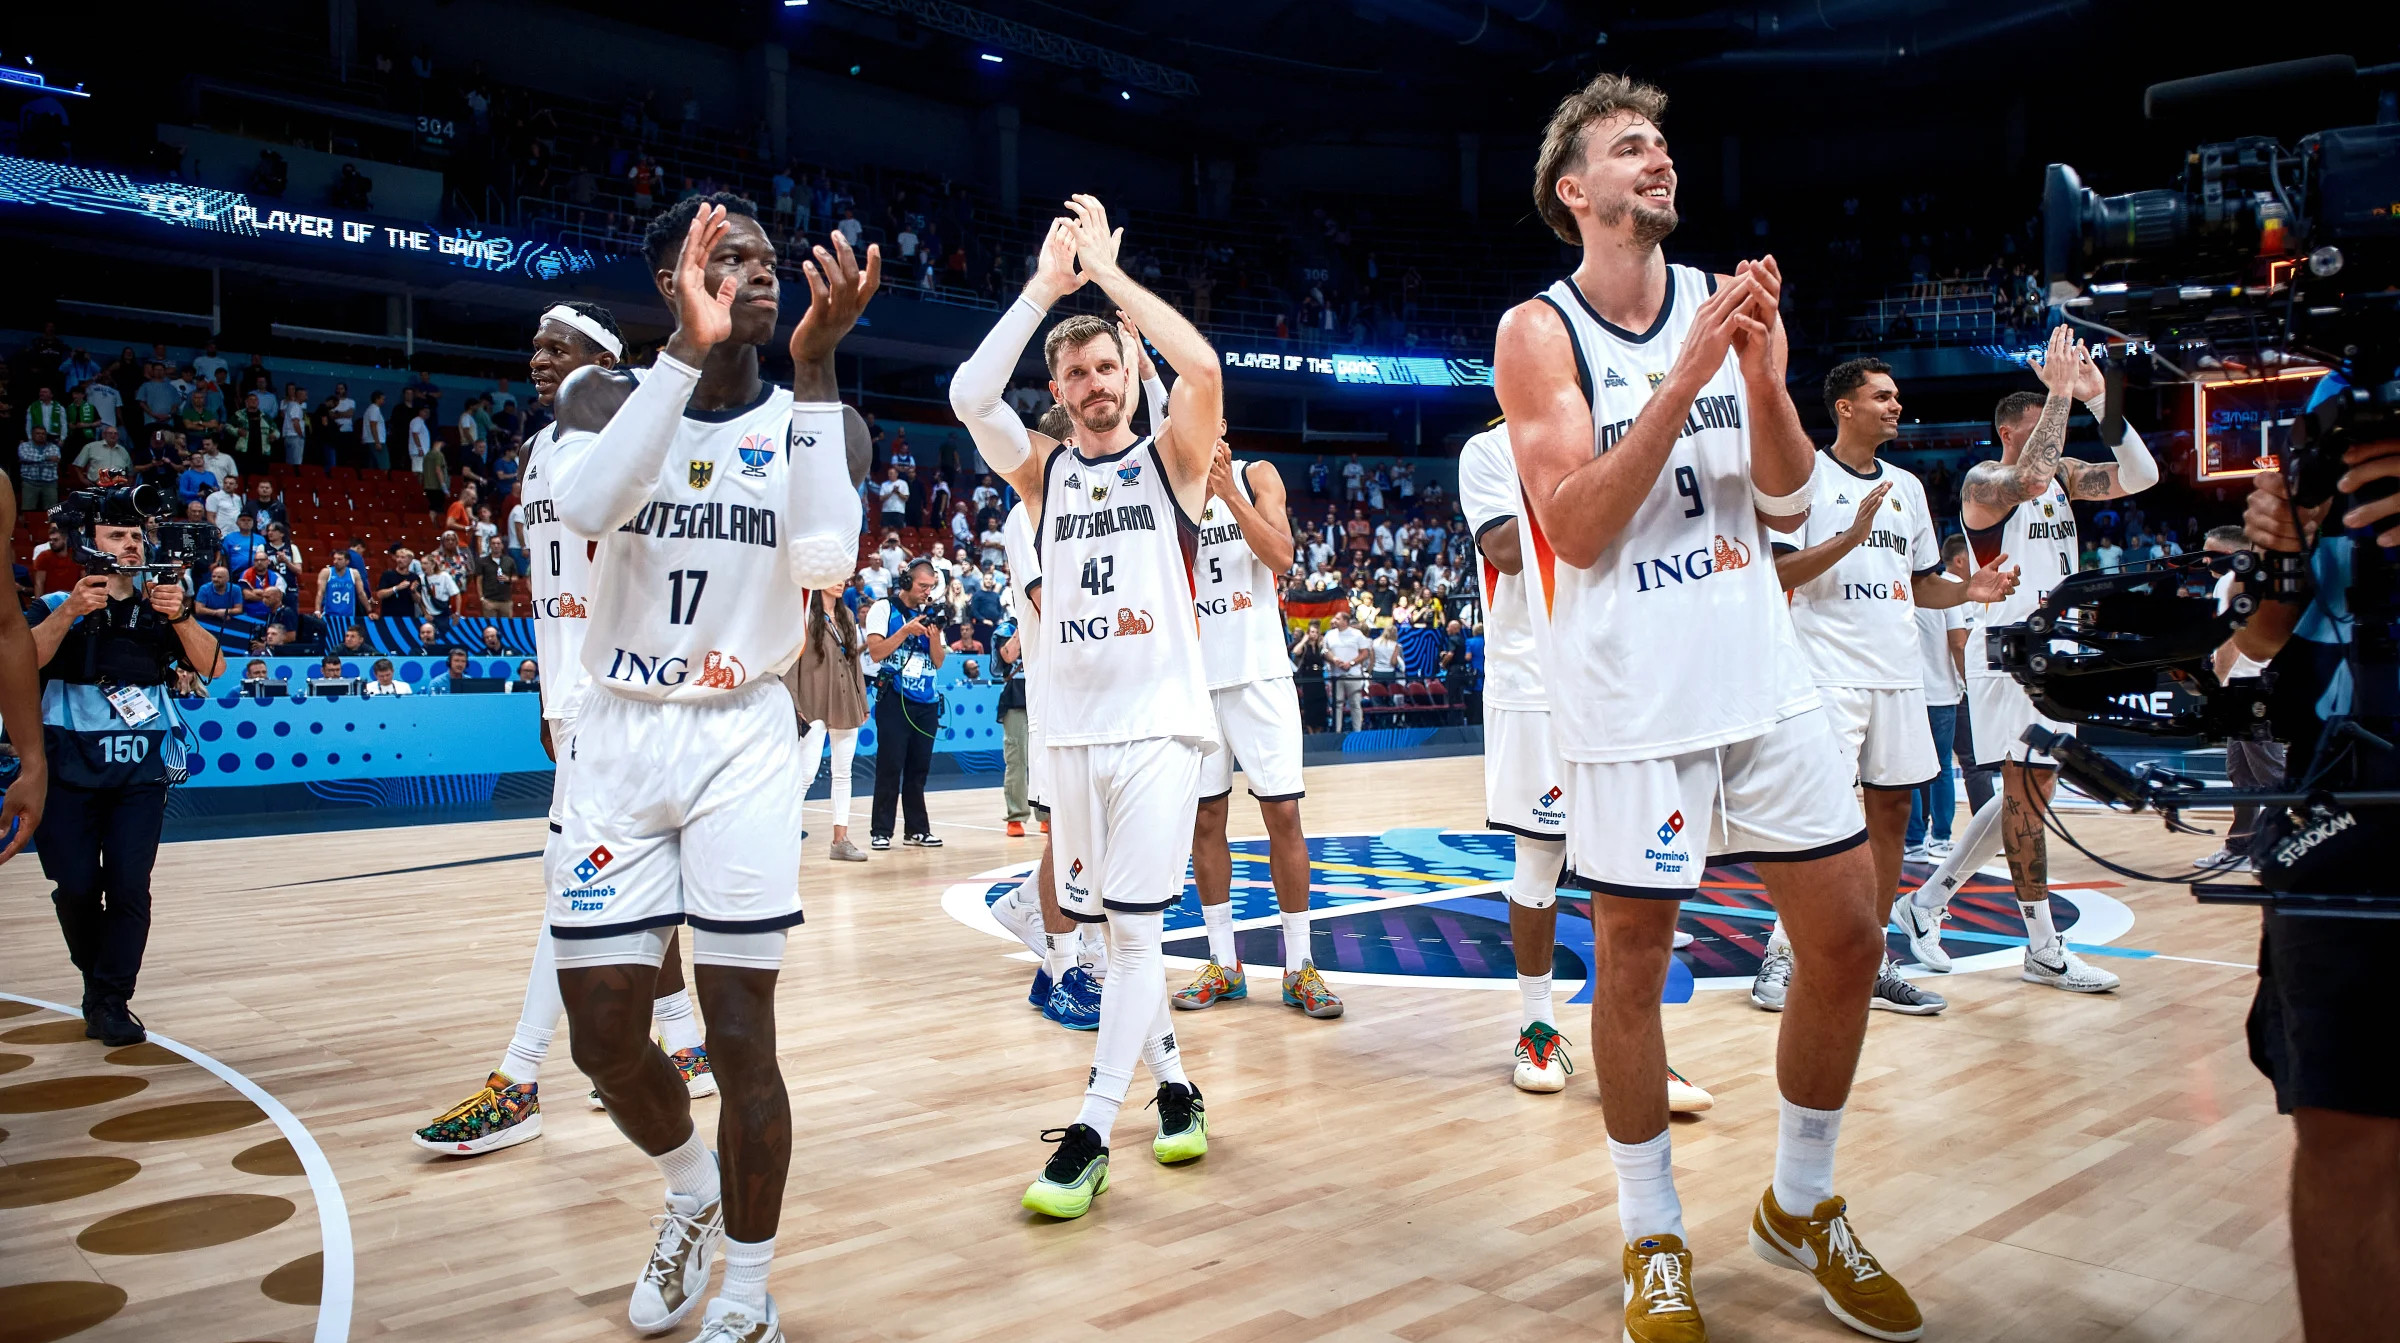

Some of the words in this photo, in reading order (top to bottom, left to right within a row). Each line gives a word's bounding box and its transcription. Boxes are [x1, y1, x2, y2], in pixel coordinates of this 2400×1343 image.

[417, 116, 455, 138] 304
[140, 193, 218, 221] TCL
[234, 205, 333, 238] PLAYER
[343, 221, 375, 243] OF
[384, 227, 430, 251] THE
[438, 235, 504, 262] GAME
[1225, 352, 1280, 369] PLAYER
[1283, 355, 1303, 371] OF
[1306, 357, 1333, 374] THE
[1337, 360, 1379, 375] GAME
[1604, 377, 1628, 388] PEAK
[1064, 480, 1081, 490] PEAK
[1675, 465, 1704, 518] 9
[618, 501, 777, 548] UTSCHLAND
[1081, 554, 1115, 596] 42
[1209, 557, 1223, 584] 5
[1633, 547, 1714, 593] ING
[332, 591, 350, 605] 34
[668, 569, 709, 625] 17
[1843, 583, 1888, 600] ING
[1196, 598, 1227, 618] NG
[1060, 616, 1110, 643] ING
[606, 648, 689, 686] ING
[98, 735, 149, 763] 150
[1532, 808, 1566, 819] Domino's
[1538, 816, 1560, 825] Pizza
[2277, 811, 2357, 867] STEADICAM
[1645, 849, 1689, 862] Domino's
[1655, 861, 1682, 873] Pizza
[562, 885, 616, 898] Domino's
[571, 900, 604, 911] Pizza
